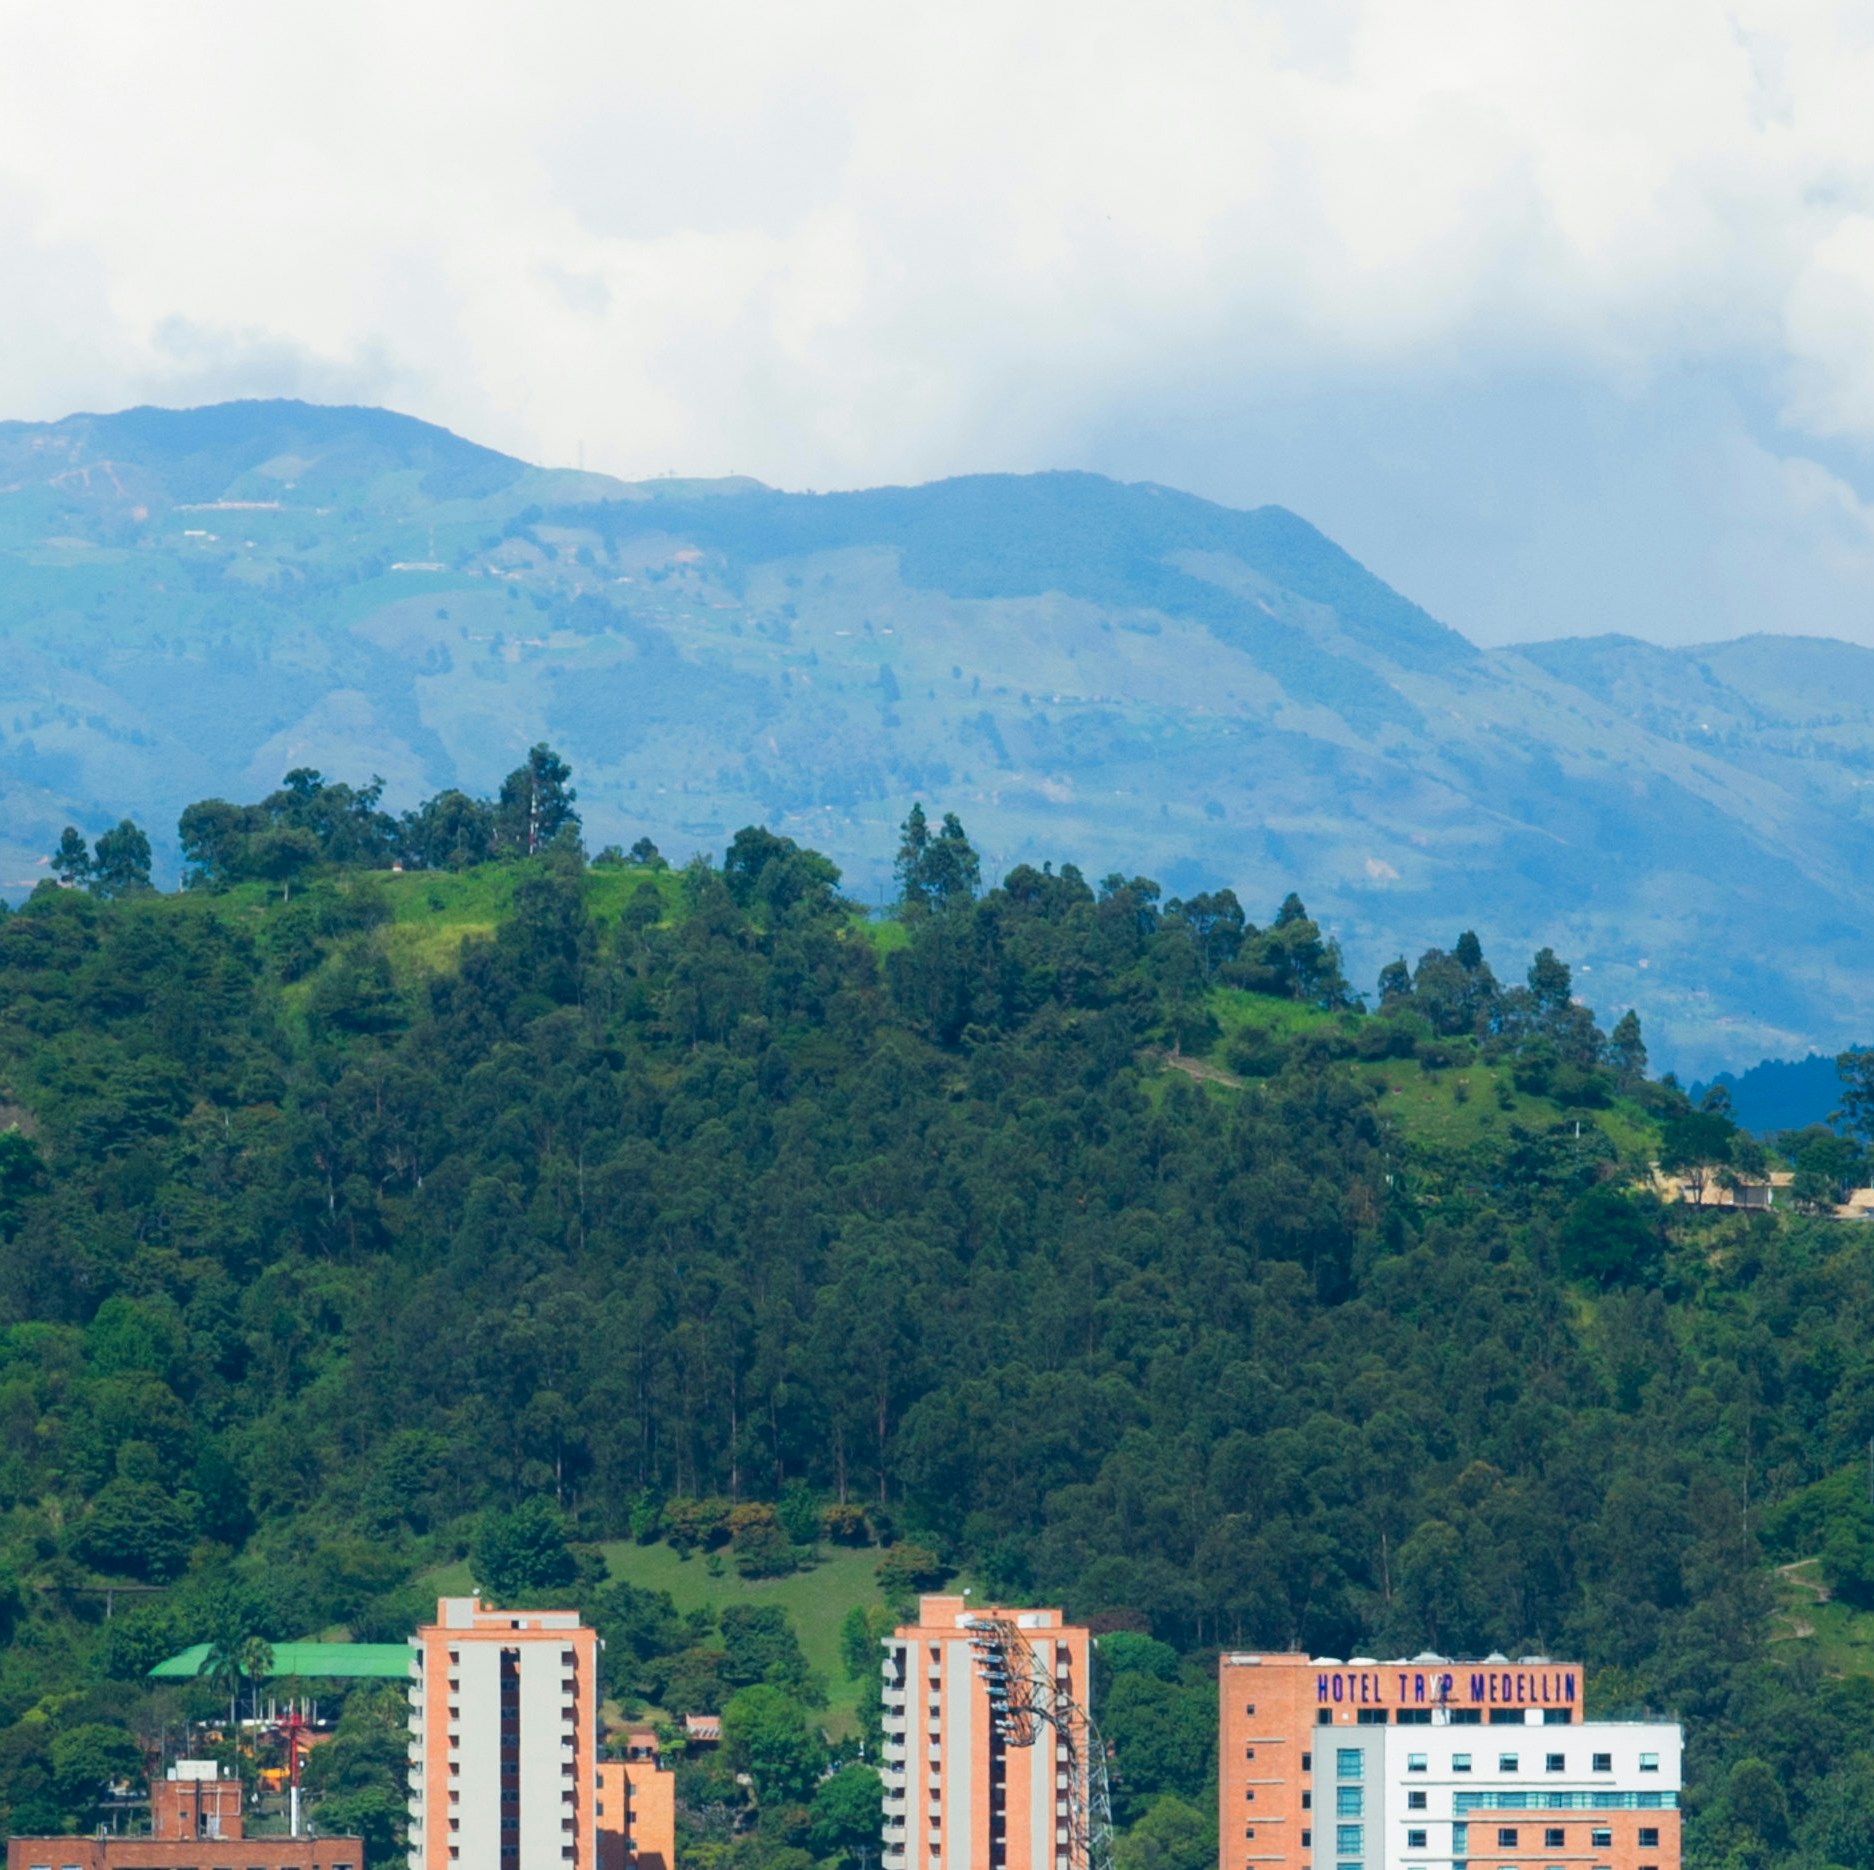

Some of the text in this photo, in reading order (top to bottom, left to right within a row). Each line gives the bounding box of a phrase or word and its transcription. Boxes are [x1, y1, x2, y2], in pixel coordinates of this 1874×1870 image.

[1317, 1673, 1576, 1703] HOTEL TRYP MEDELLIN
